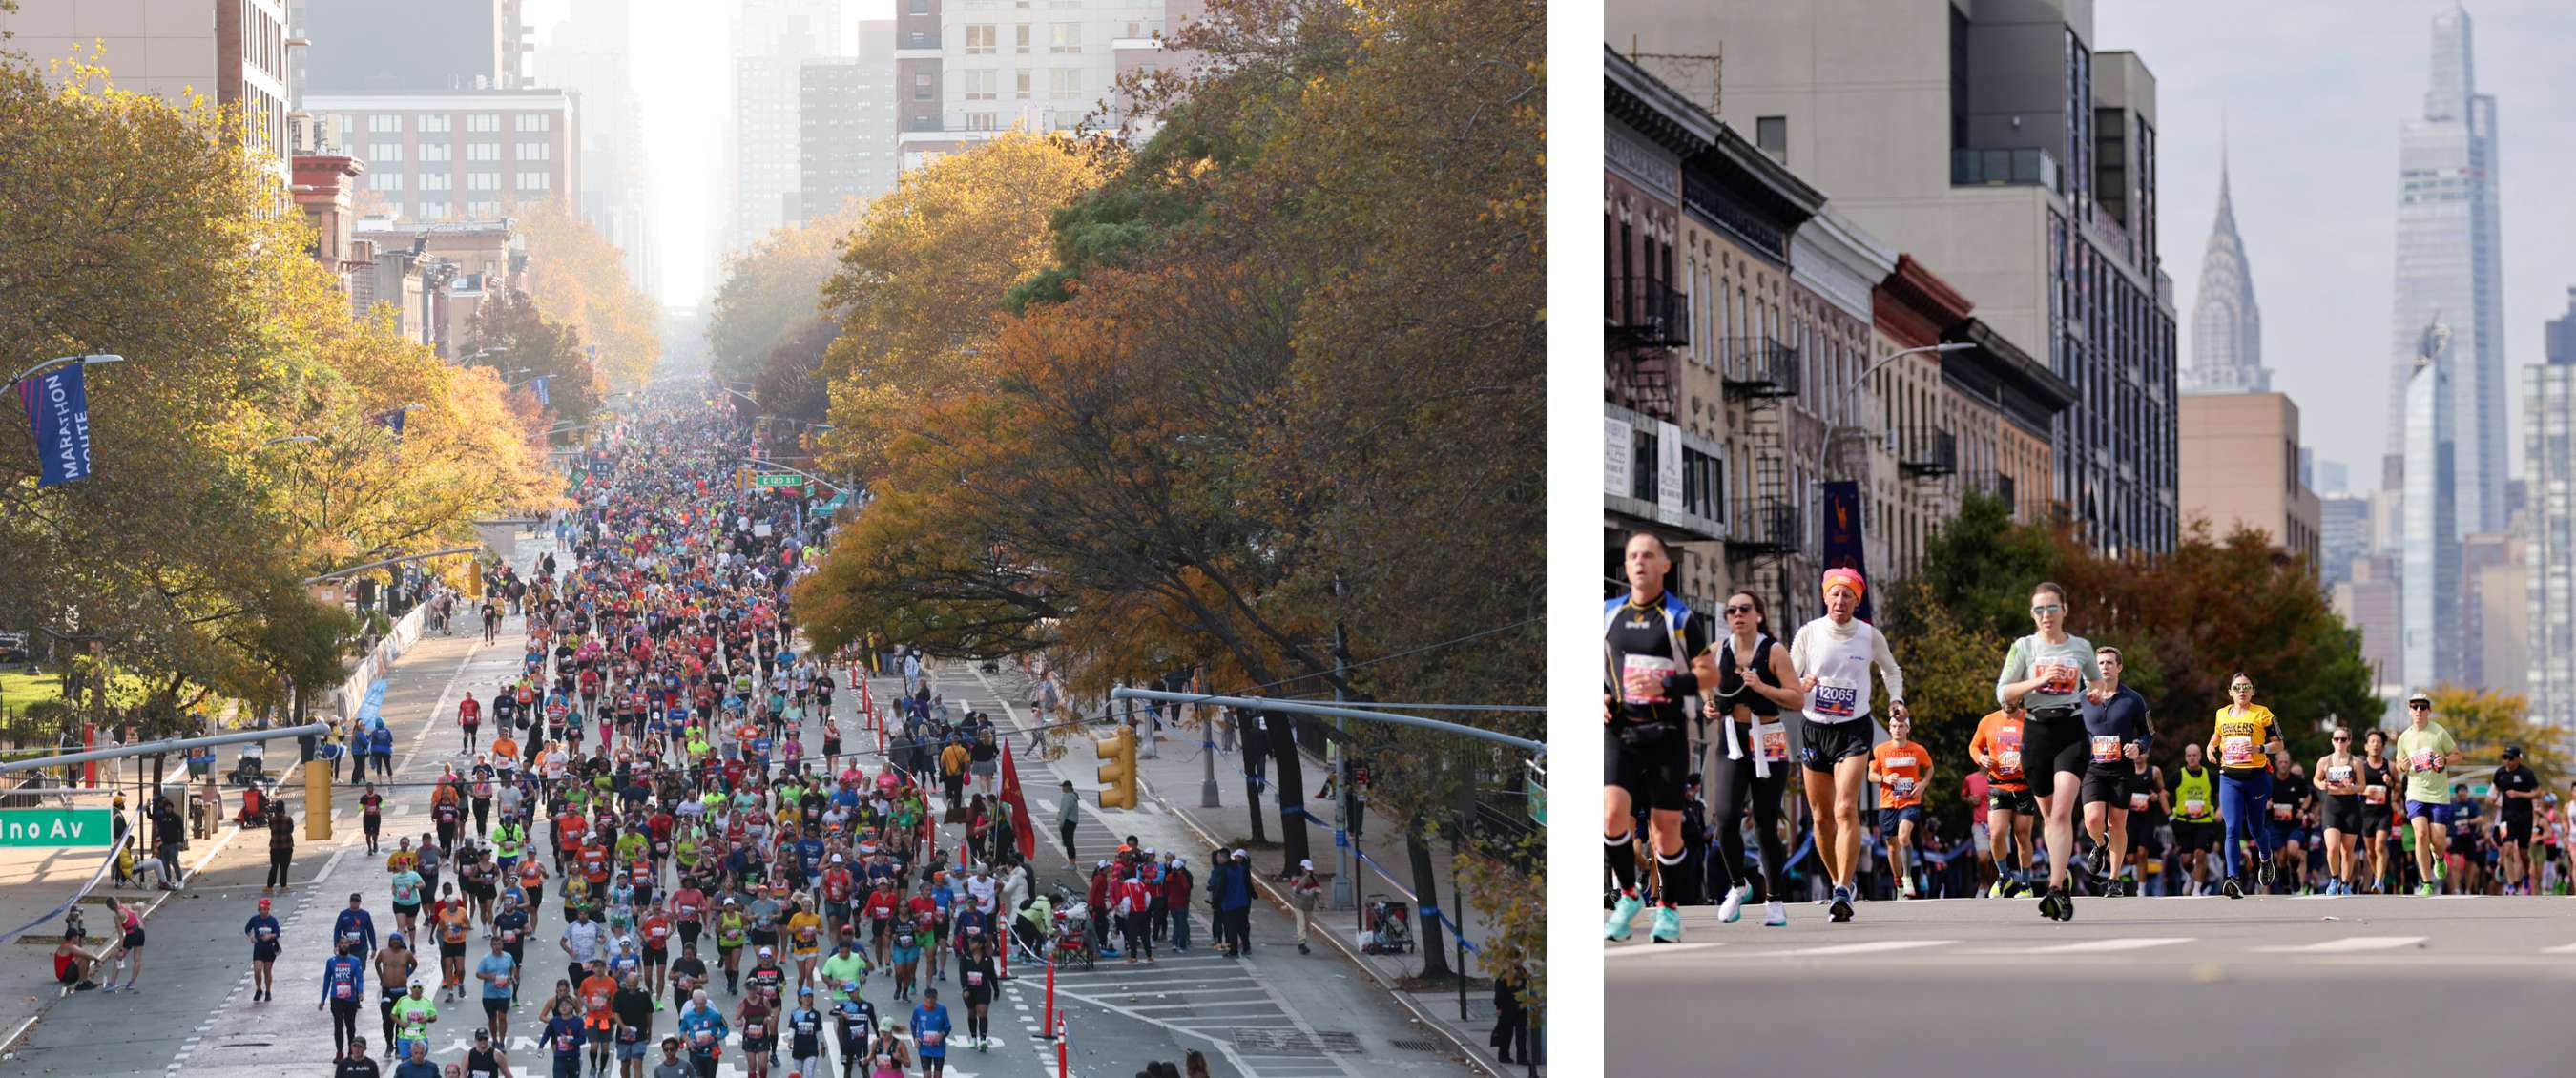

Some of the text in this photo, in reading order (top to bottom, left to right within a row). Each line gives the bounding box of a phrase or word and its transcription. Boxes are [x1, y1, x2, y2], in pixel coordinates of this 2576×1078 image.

[46, 374, 79, 479] MARATHON
[1818, 686, 1854, 702] 12065
[50, 818, 83, 839] Av
